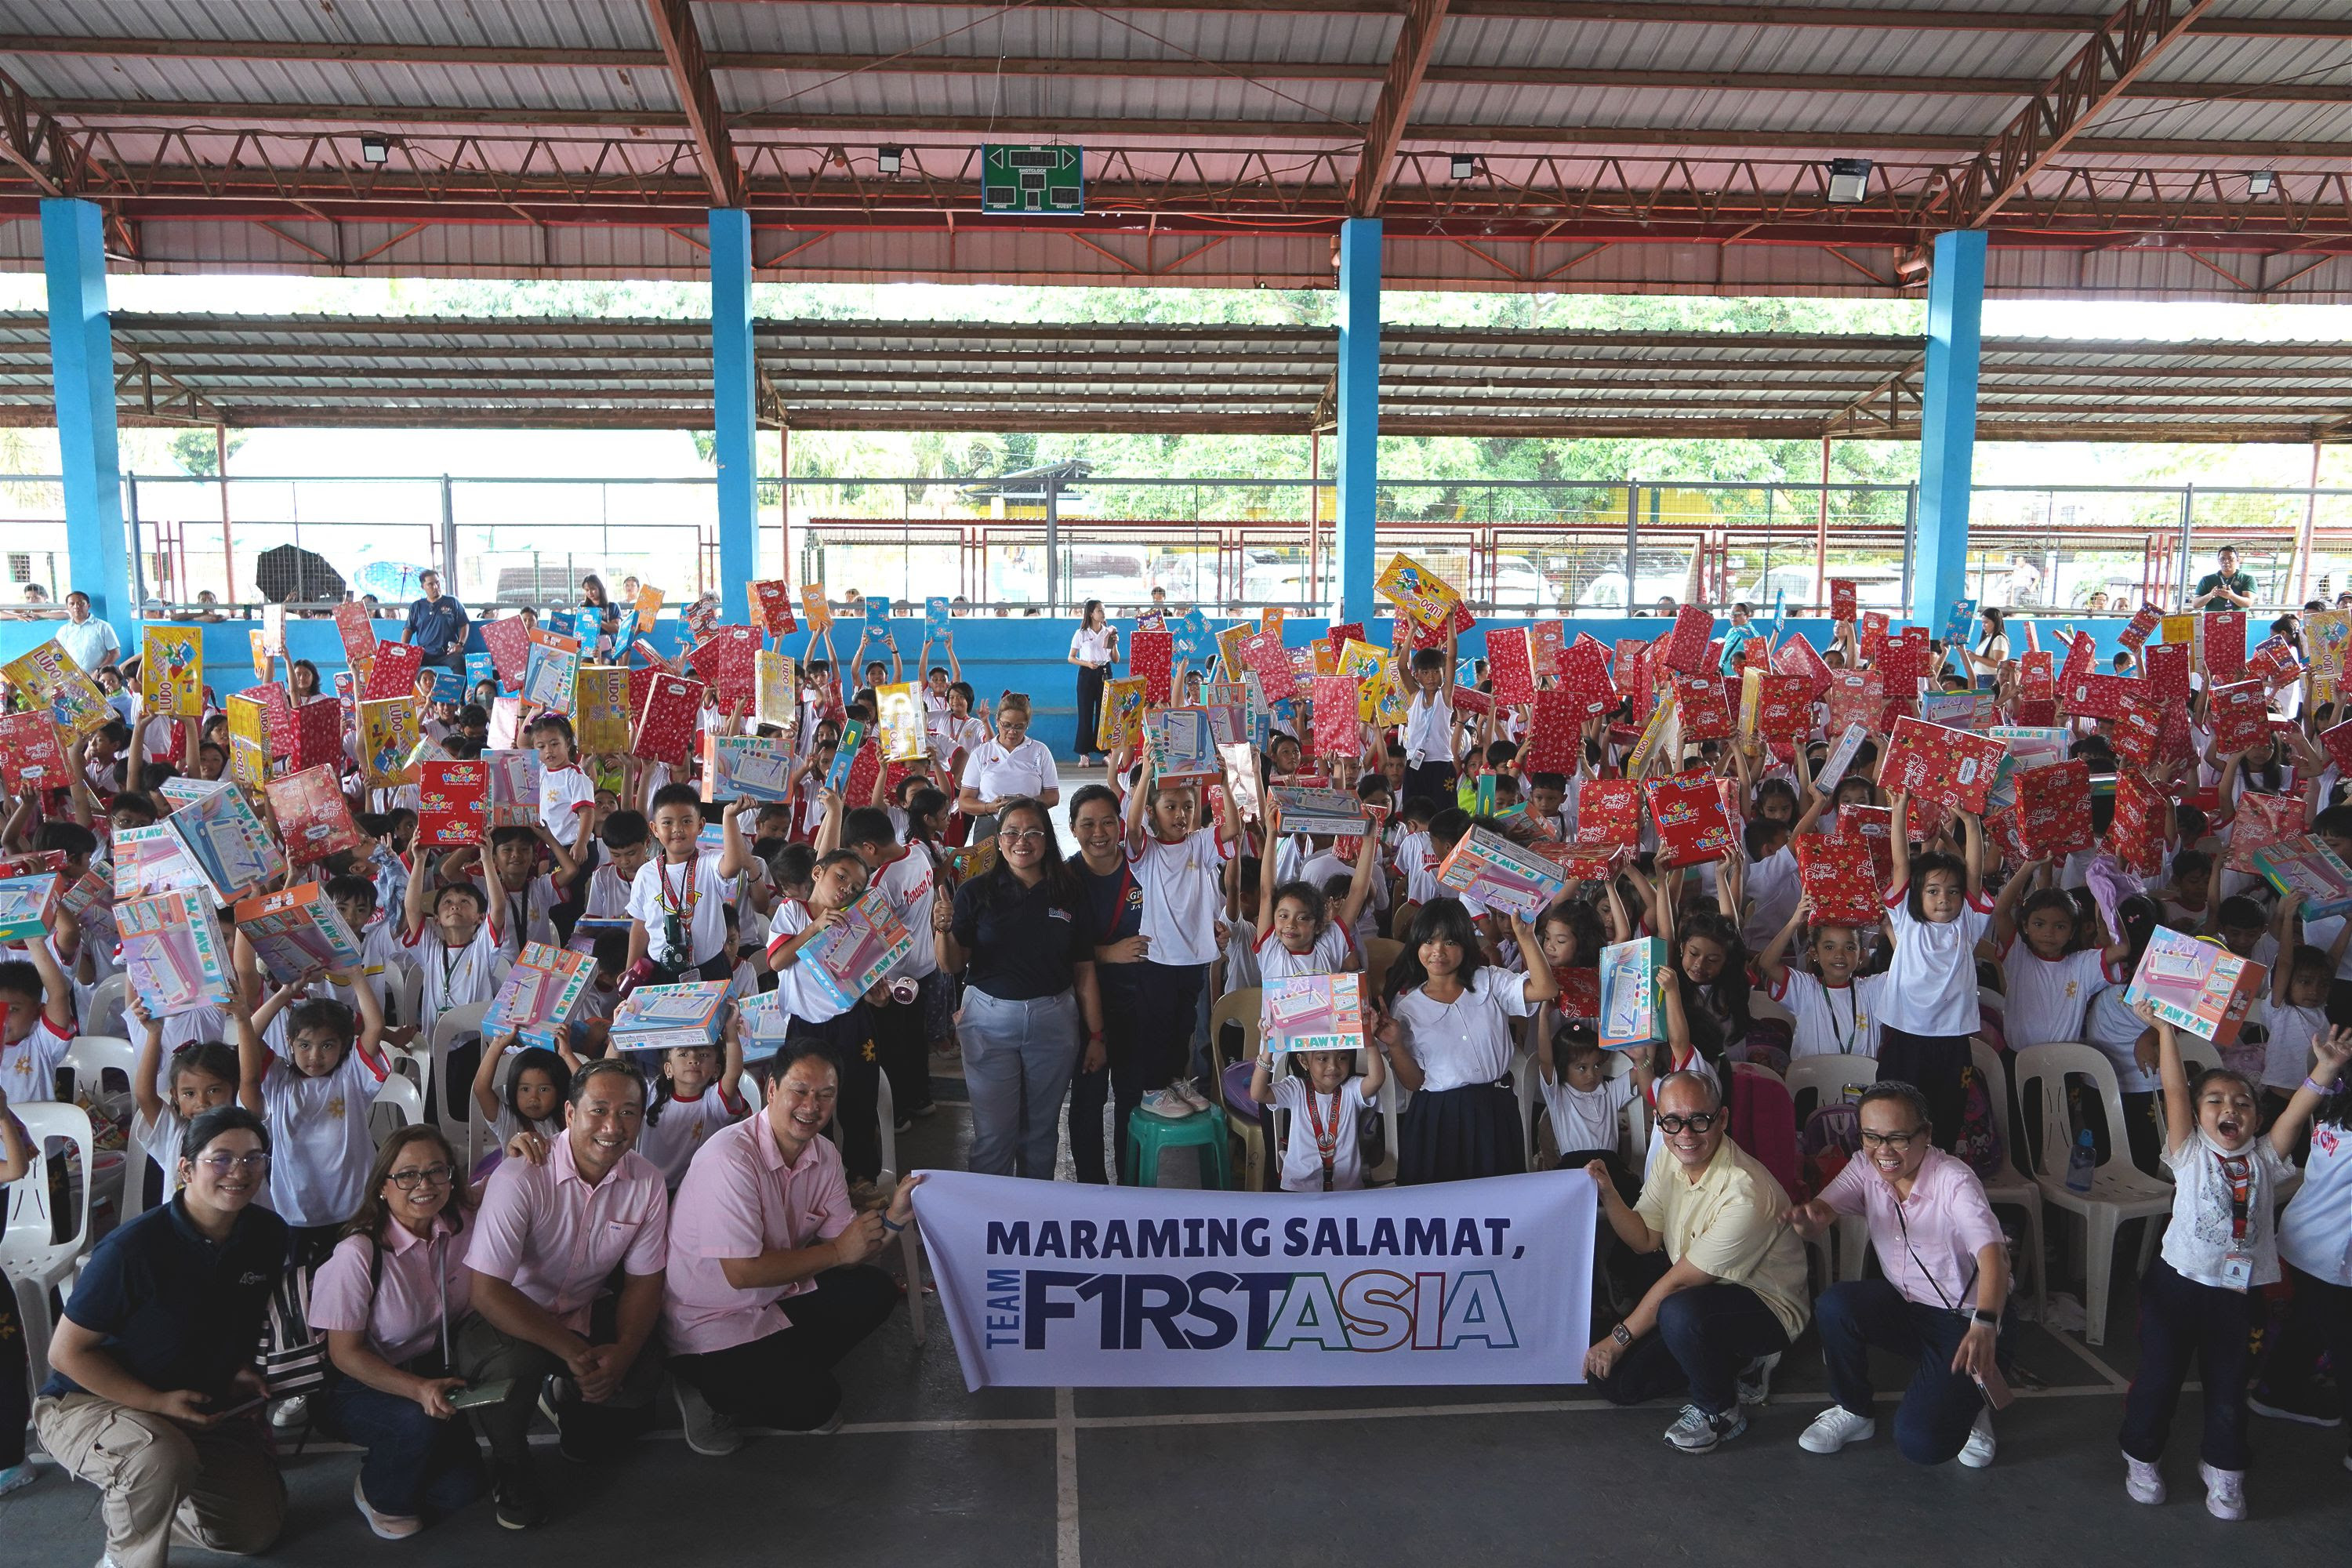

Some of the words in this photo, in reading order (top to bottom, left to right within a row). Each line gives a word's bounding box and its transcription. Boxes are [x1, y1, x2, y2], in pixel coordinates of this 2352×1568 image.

[1420, 598, 1444, 619] LUDO
[33, 650, 64, 680] LUDO
[1388, 660, 1399, 683] LUDO
[159, 682, 172, 711] LUDO
[608, 672, 620, 703] LUDO
[260, 707, 269, 733] LUDO
[388, 703, 404, 732] LUDO
[1246, 709, 1254, 737] DRAW
[718, 739, 748, 749] DRAW
[1112, 723, 1122, 746] LUDO
[1632, 739, 1650, 760] LUDO
[236, 750, 246, 782] LUDO
[452, 764, 473, 774] TOY
[225, 788, 253, 821] DRAW
[1666, 803, 1687, 812] TOY
[447, 820, 468, 830] TOY
[1498, 859, 1535, 879] DRAW
[1806, 869, 1838, 880] Christmas
[1810, 863, 1832, 873] Merry
[903, 880, 928, 907] Tanauan
[195, 932, 215, 971] DRAW
[863, 955, 891, 985] DRAW
[555, 982, 578, 1014] DRAW
[636, 984, 670, 994] DRAW
[1294, 1036, 1330, 1048] DRAW
[986, 1217, 1271, 1259] MARAMING
[1283, 1217, 1526, 1259] SALAMAT,
[986, 1269, 1020, 1349] TEAM
